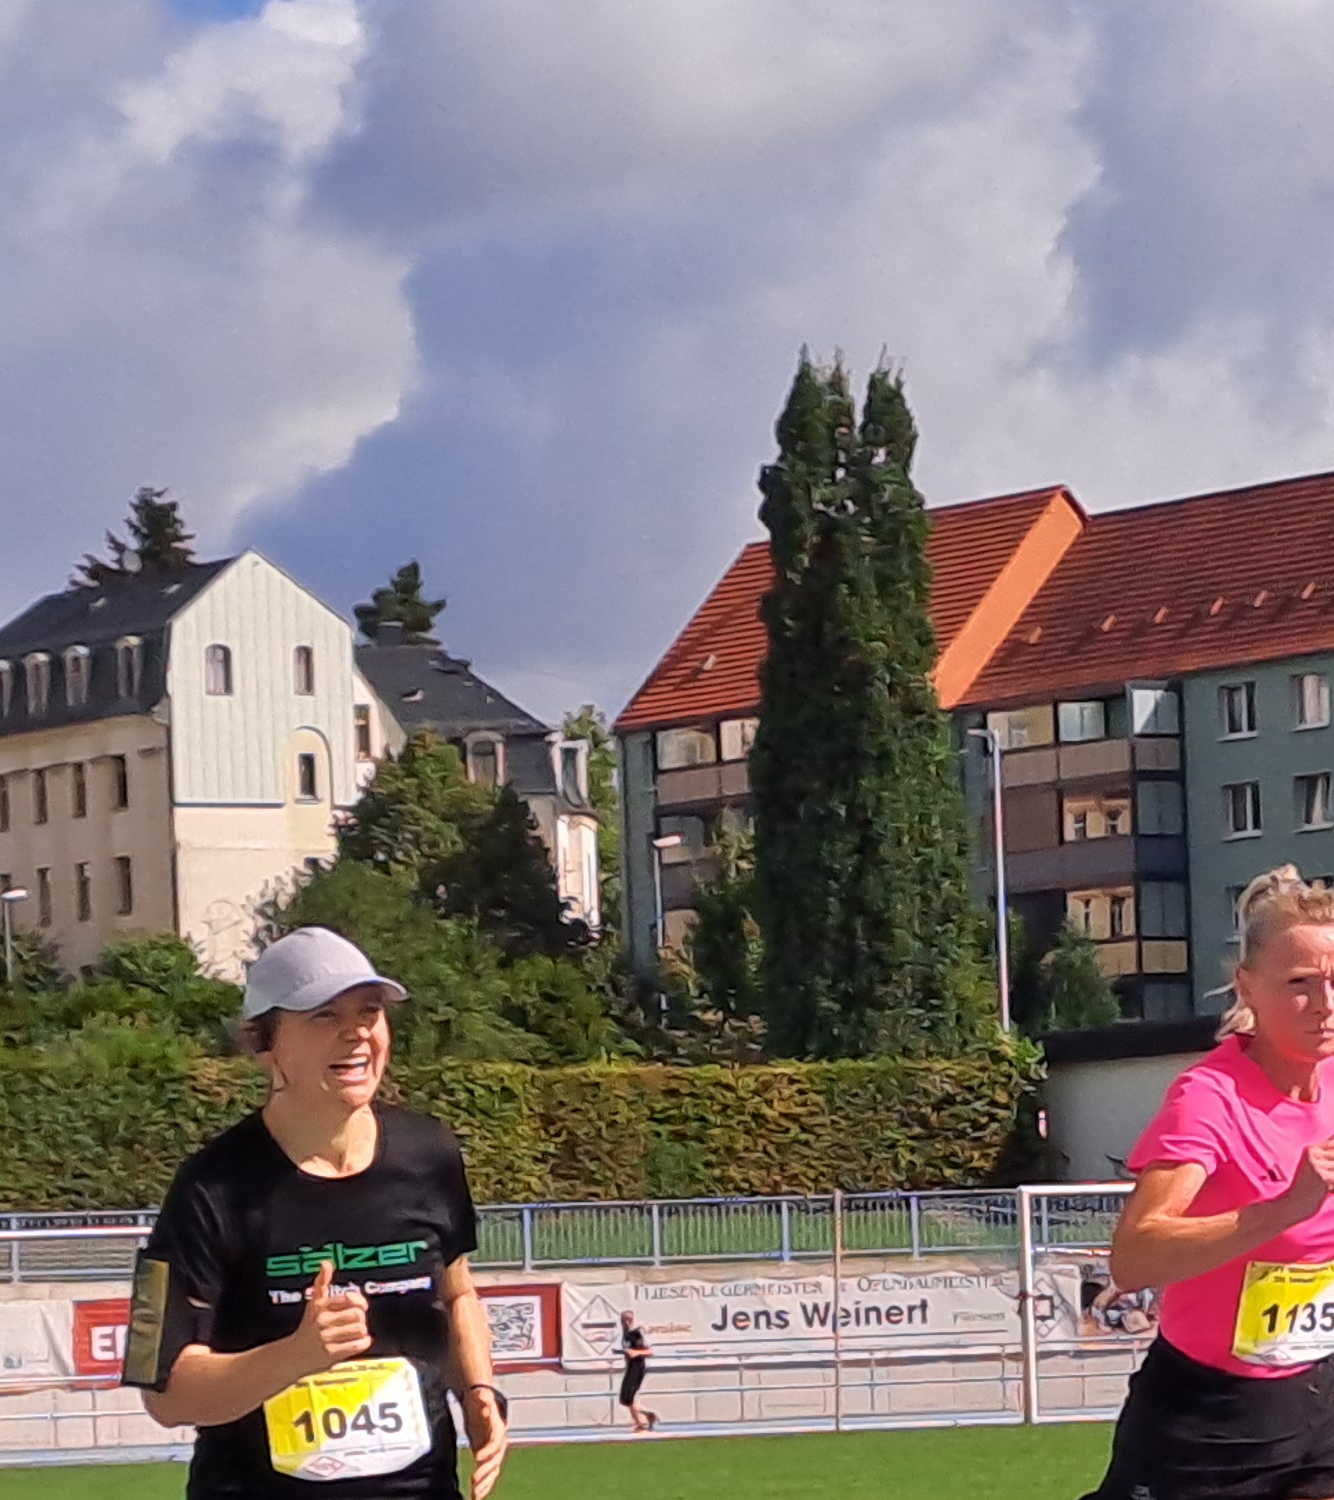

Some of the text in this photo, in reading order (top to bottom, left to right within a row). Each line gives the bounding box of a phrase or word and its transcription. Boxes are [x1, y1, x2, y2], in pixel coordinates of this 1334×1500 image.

[711, 1303, 790, 1331] Jens
[799, 1298, 928, 1329] Weinert
[292, 1402, 404, 1444] 1045
